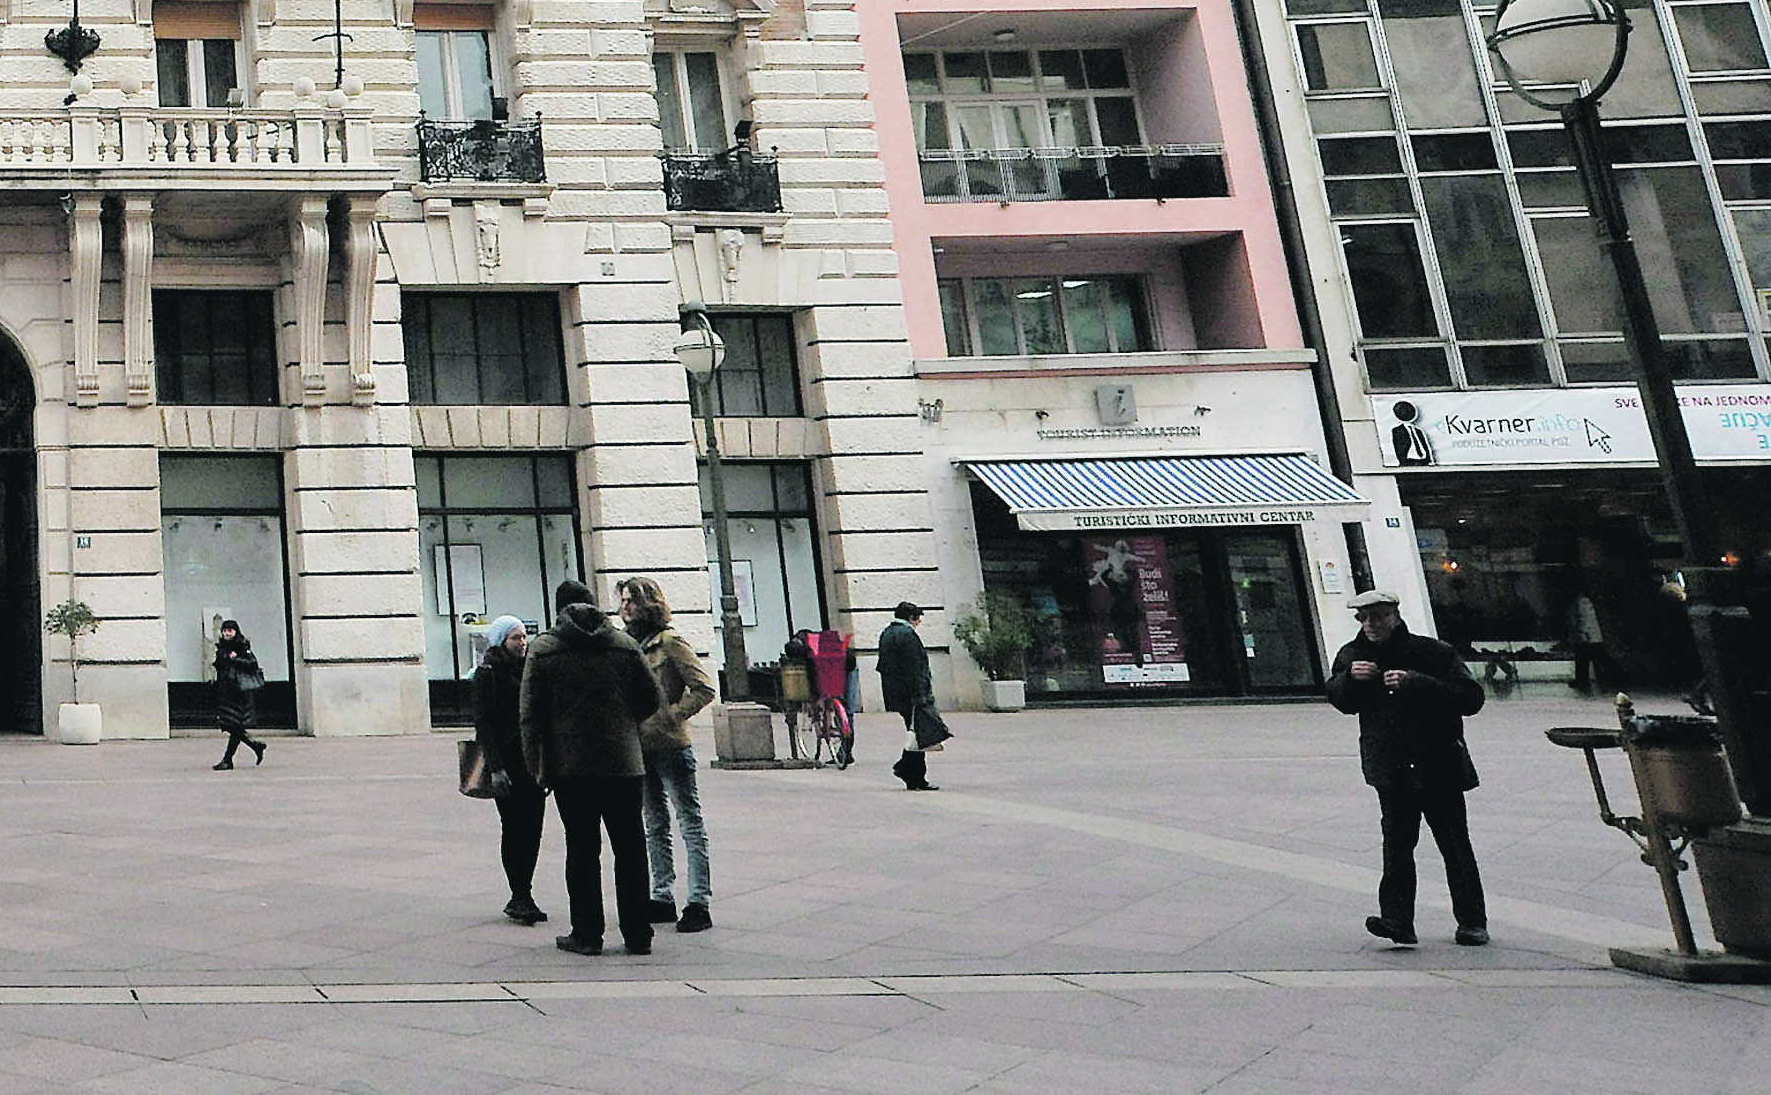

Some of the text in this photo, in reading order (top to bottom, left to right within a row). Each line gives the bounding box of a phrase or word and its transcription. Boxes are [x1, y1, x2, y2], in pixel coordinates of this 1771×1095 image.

[1614, 397, 1639, 408] SVE
[1692, 396, 1713, 406] NA
[1716, 394, 1771, 406] JEDNOM
[1074, 510, 1315, 527] TURISTIČKI INFORMATIVNI CENTAR
